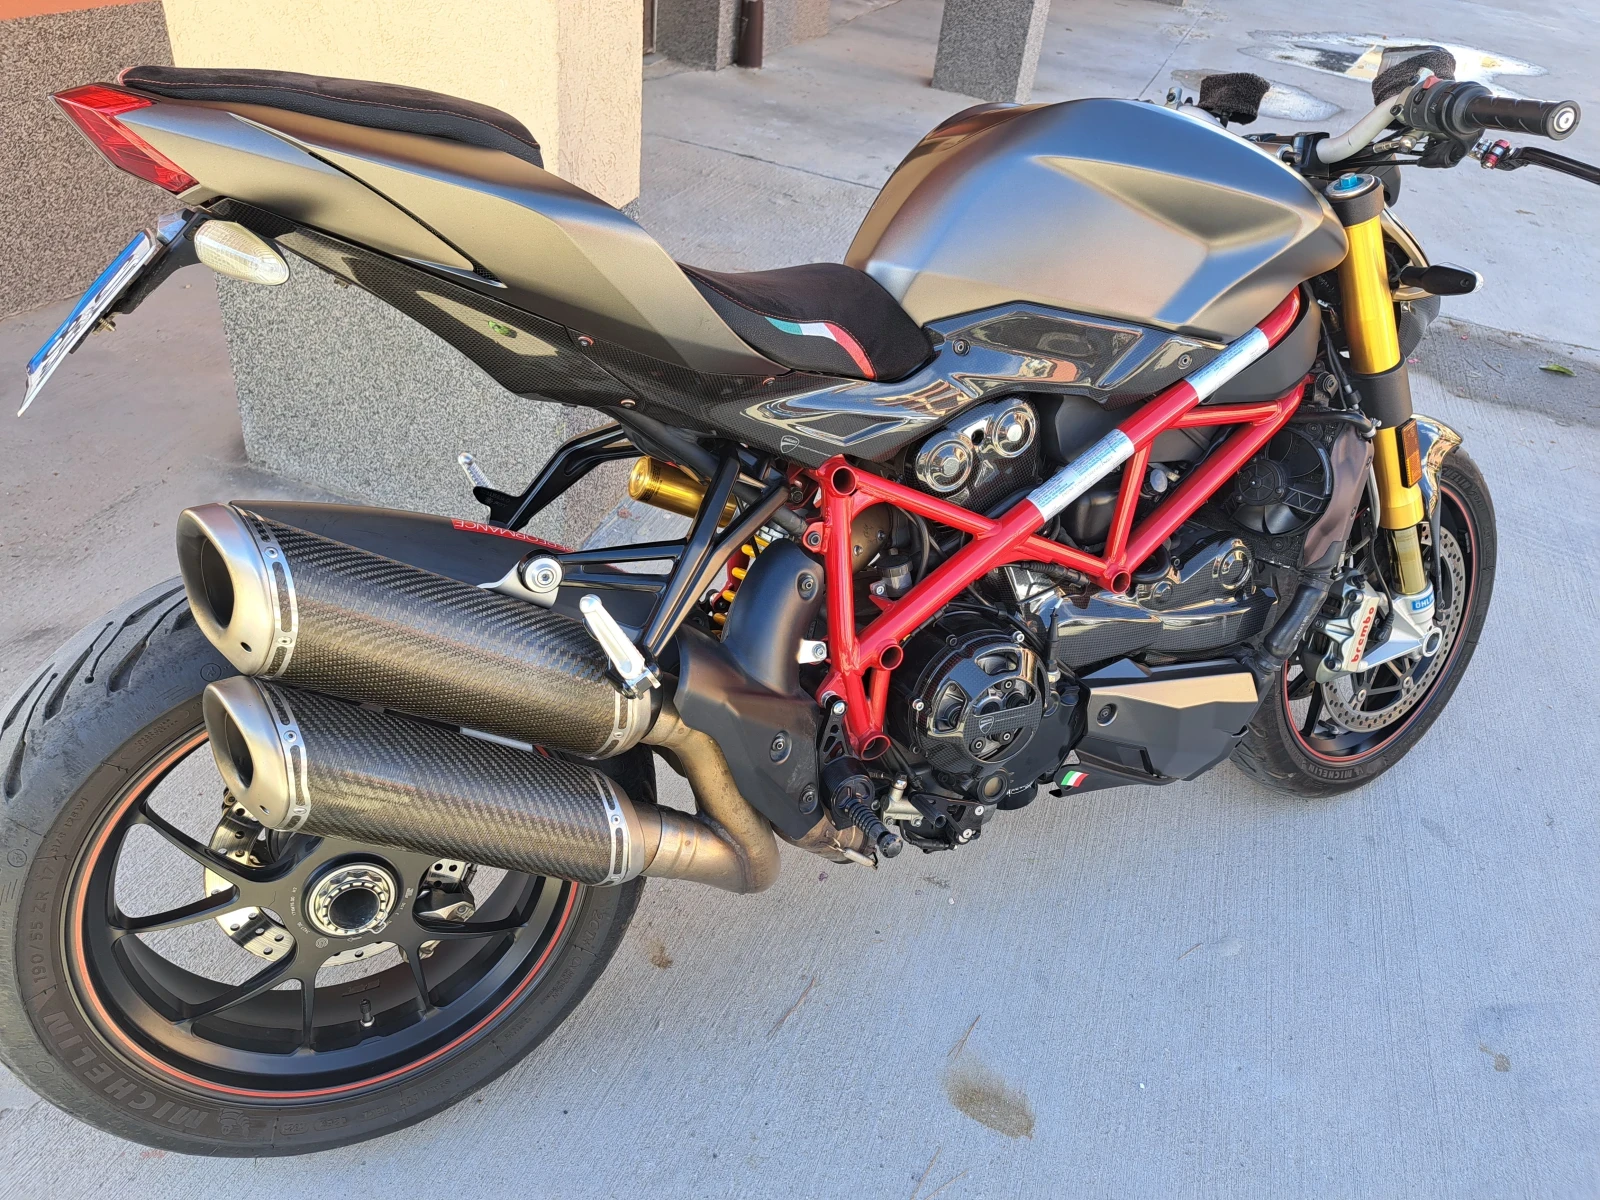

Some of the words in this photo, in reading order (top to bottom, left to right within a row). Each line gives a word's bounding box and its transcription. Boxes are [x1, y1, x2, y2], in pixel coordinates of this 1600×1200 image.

[1351, 607, 1375, 663] brembo
[1308, 764, 1353, 779] MICHELIN
[31, 891, 49, 914] ZR
[29, 921, 47, 984] 190/55
[44, 1011, 209, 1129] MICHELIN
